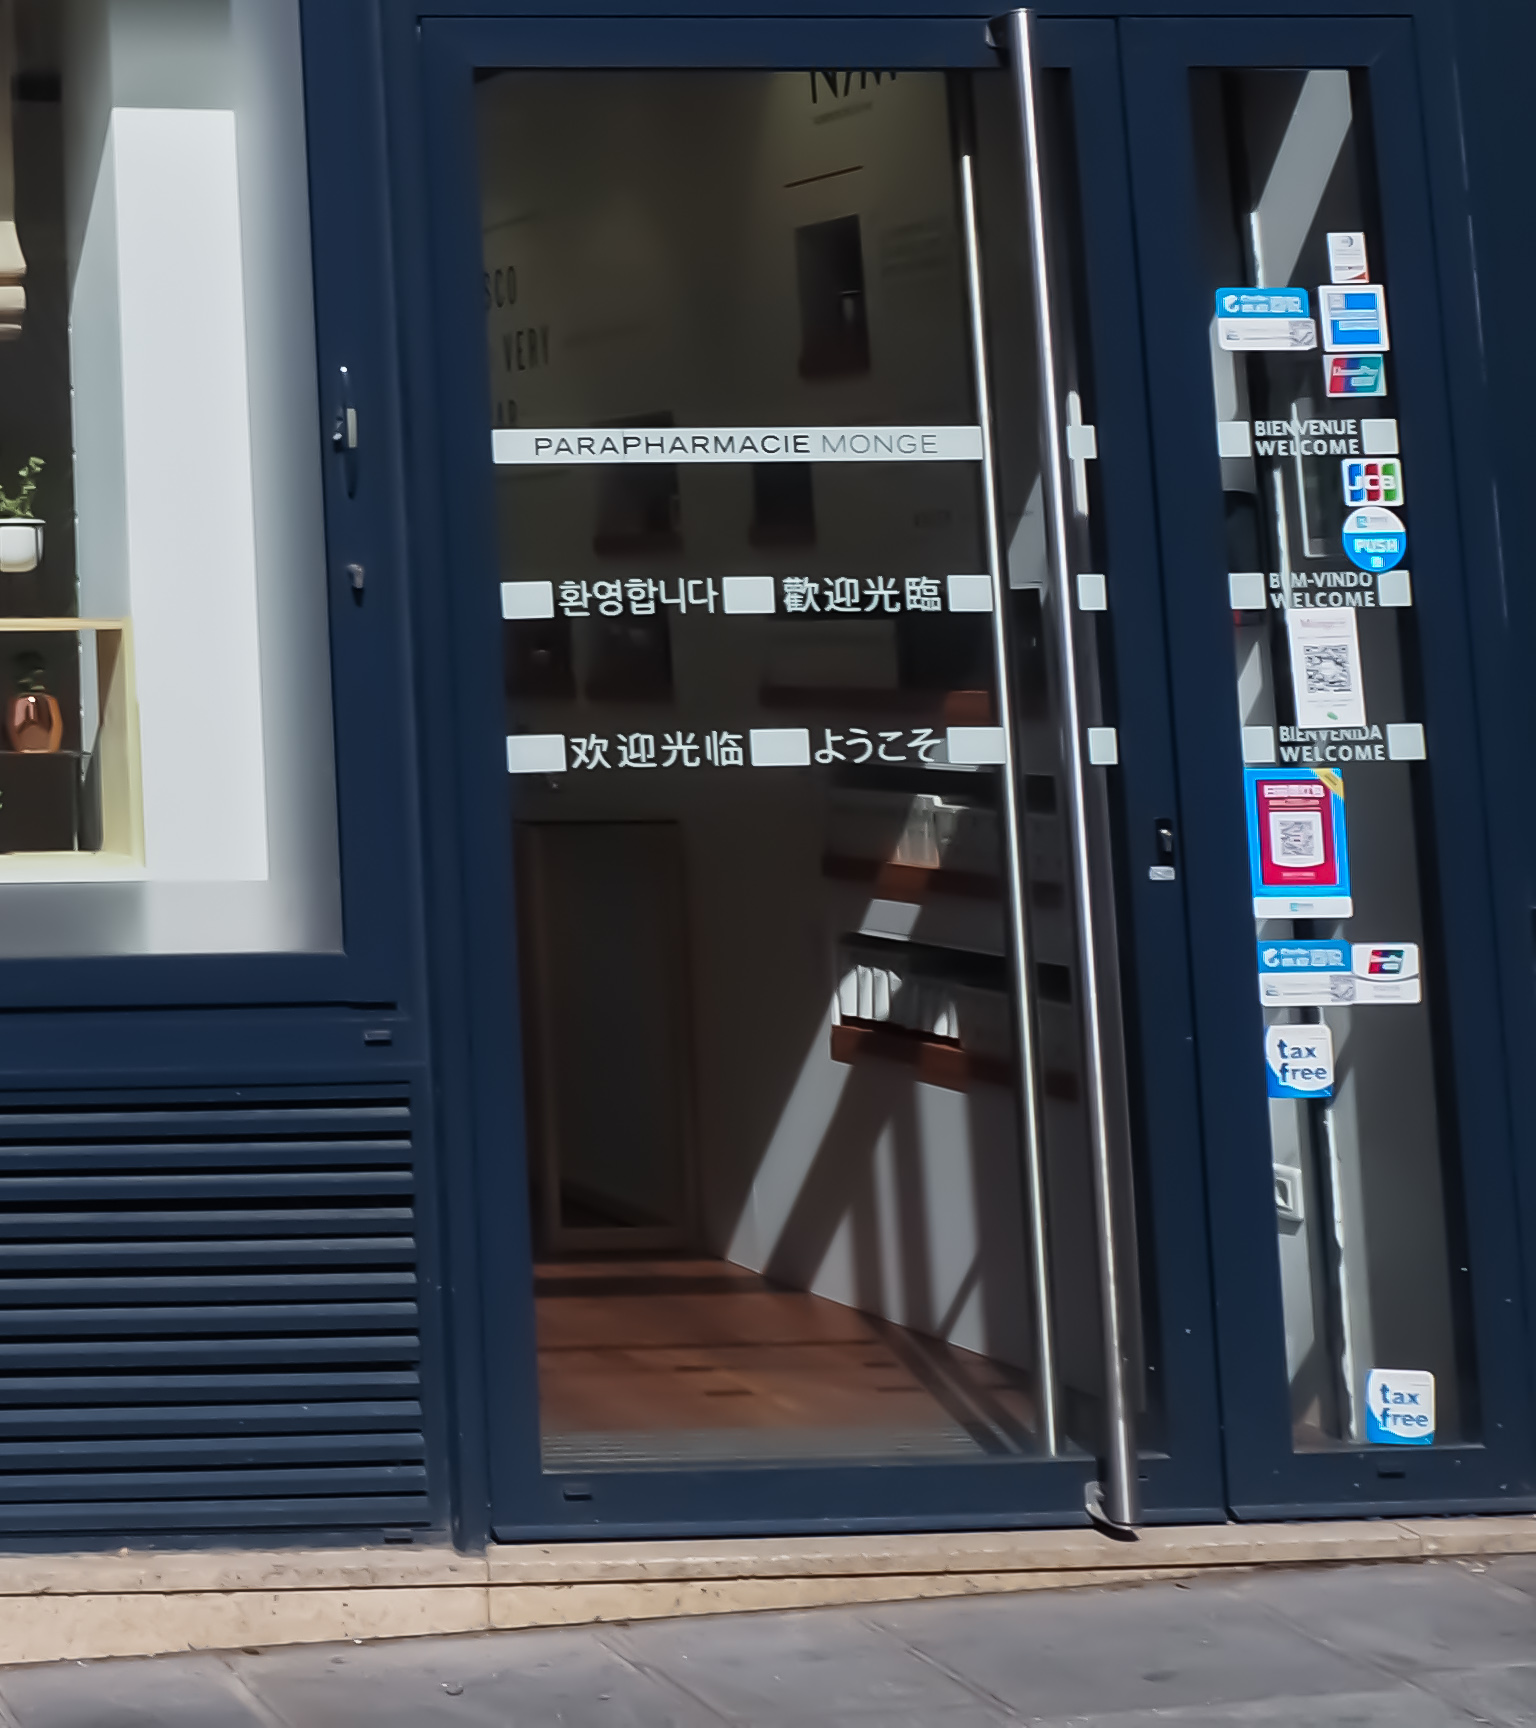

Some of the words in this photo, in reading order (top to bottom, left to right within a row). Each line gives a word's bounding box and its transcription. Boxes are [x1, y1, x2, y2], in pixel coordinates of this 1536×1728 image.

[1254, 418, 1358, 437] BIENVENUE
[534, 434, 811, 456] PARAPHARMACIE
[822, 434, 939, 454] MONGE
[1255, 438, 1360, 457] WELCOME
[557, 576, 720, 617] 환영합니다
[781, 575, 942, 613] 歡迎光臨
[1279, 725, 1383, 743] BIENVENIDA
[570, 730, 745, 770] 欢迎光临
[813, 728, 942, 765] ようこそ
[1280, 745, 1386, 763] WELCOME
[1276, 1038, 1317, 1059] tax
[1279, 1062, 1328, 1083] free
[1379, 1382, 1420, 1405] tax
[1380, 1407, 1429, 1427] free
